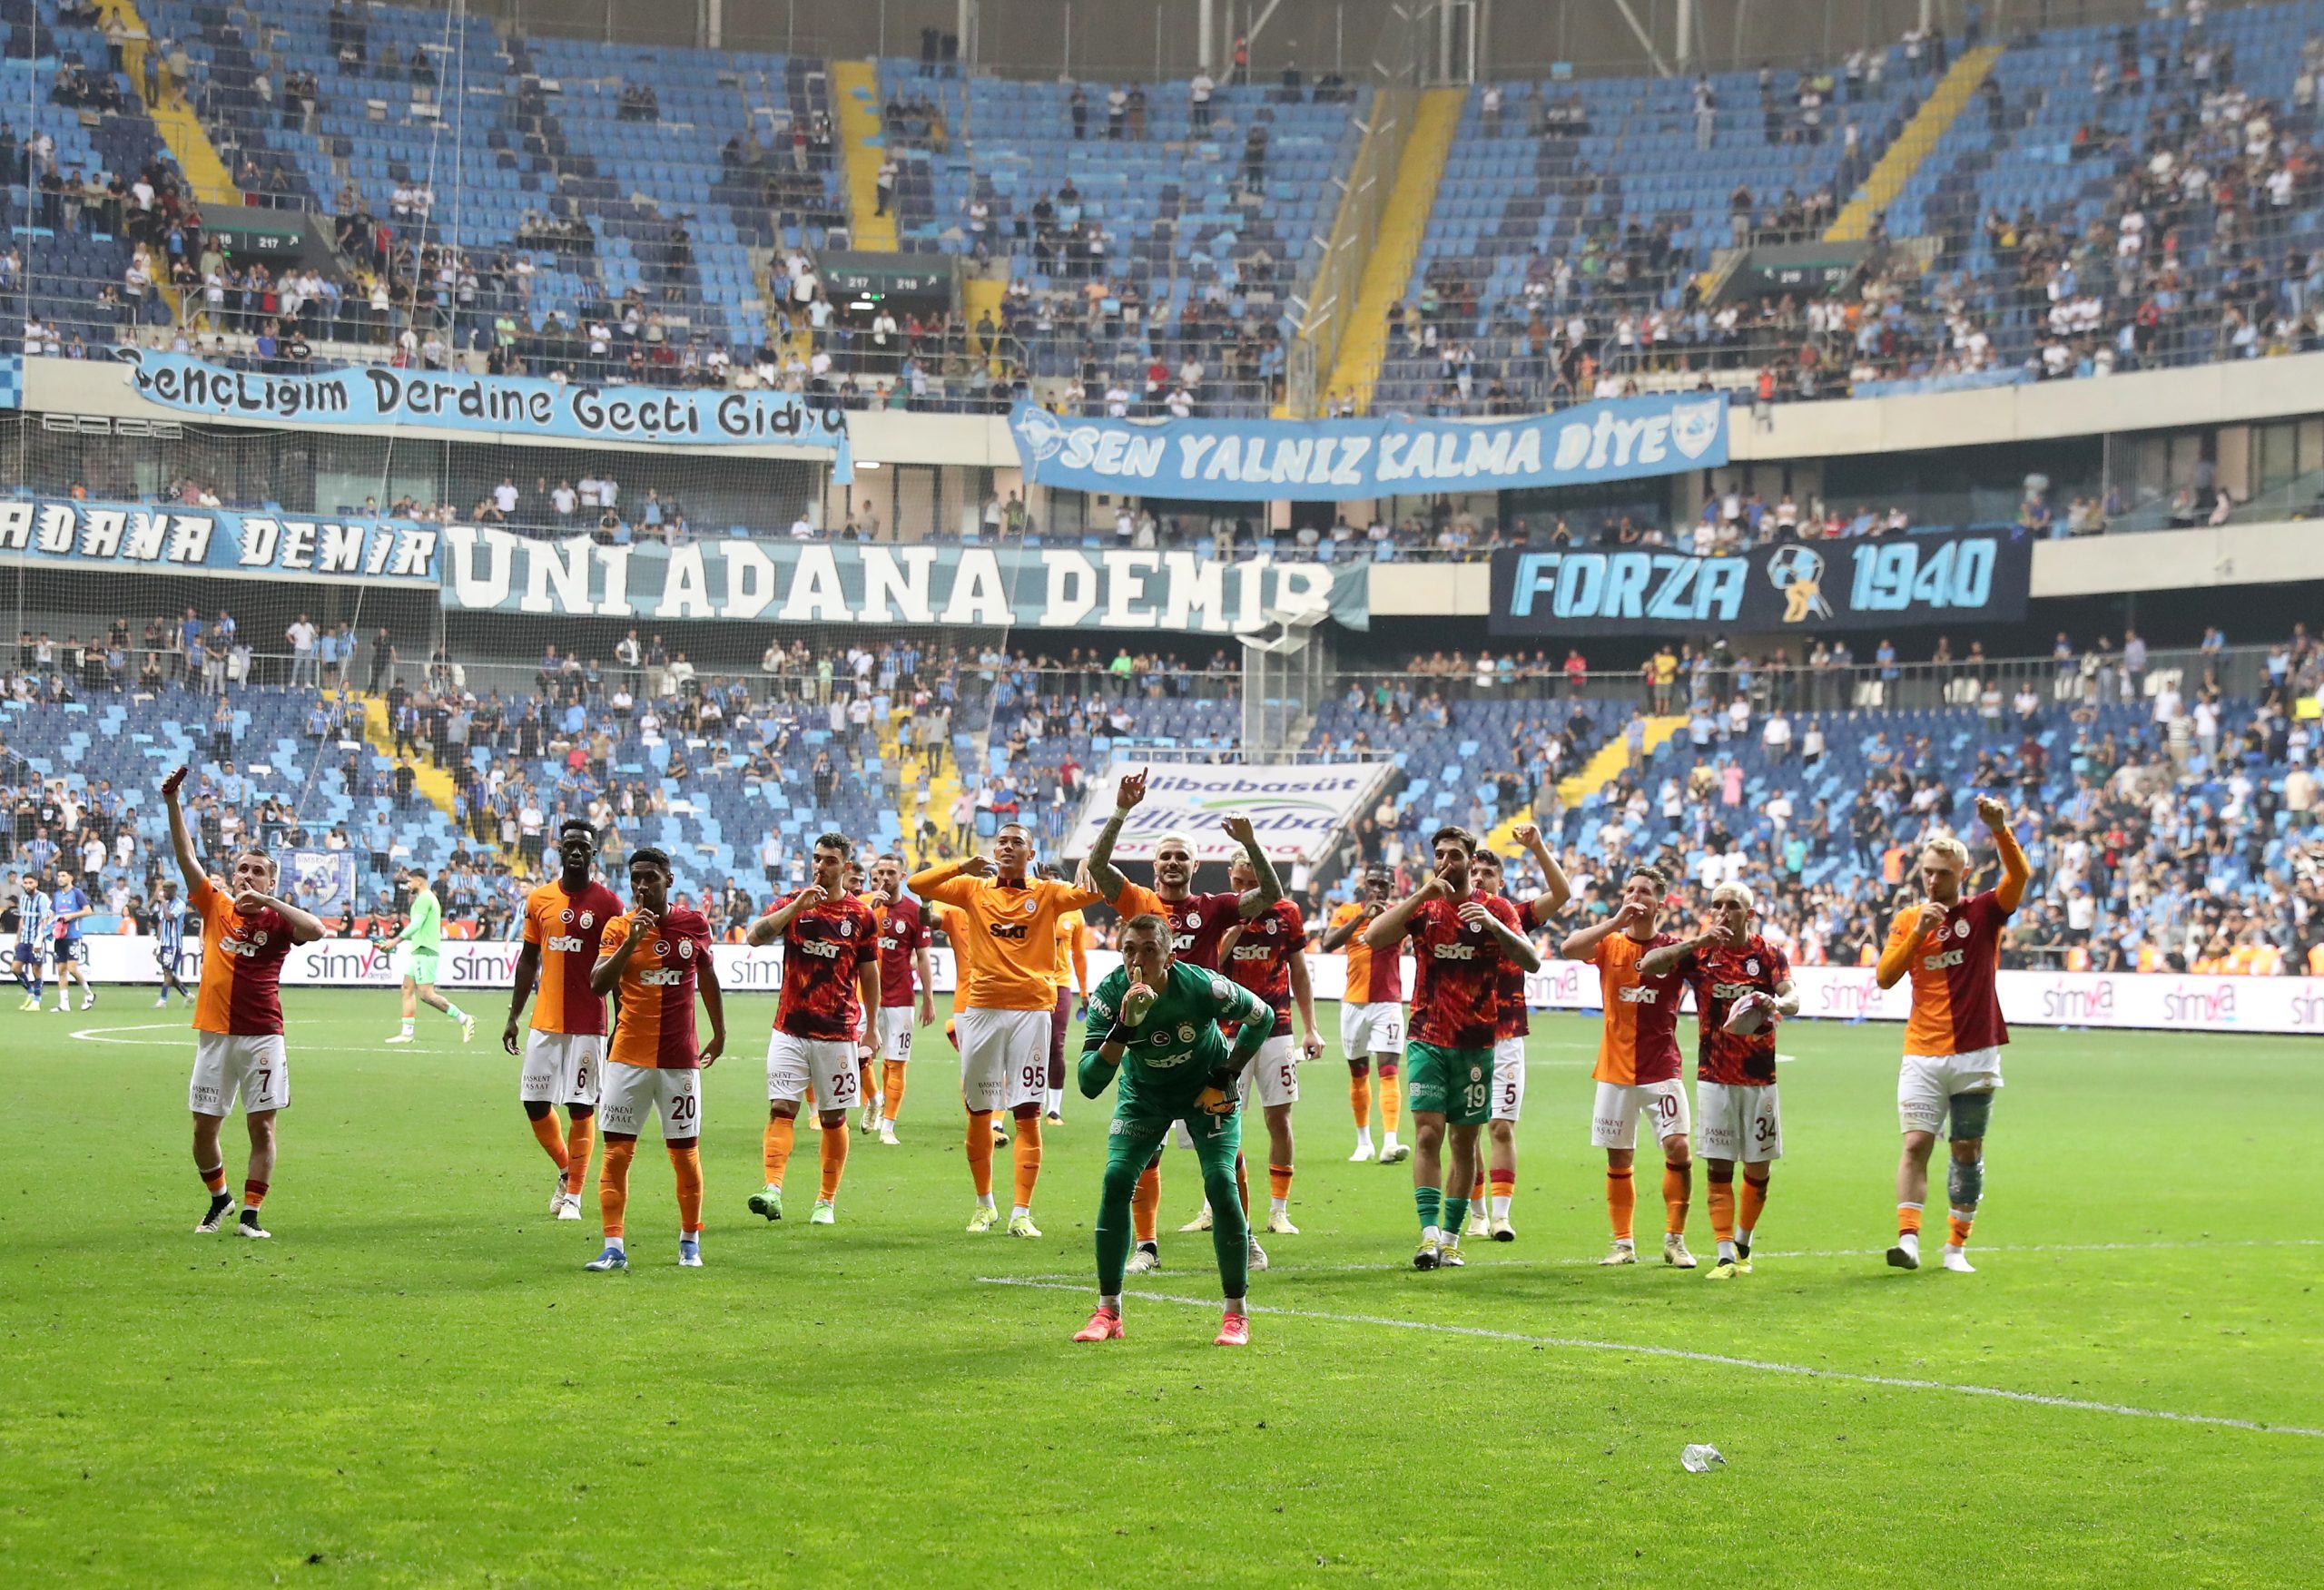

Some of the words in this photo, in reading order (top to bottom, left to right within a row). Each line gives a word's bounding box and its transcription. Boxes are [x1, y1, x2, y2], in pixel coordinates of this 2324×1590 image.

[259, 236, 279, 249] 217
[366, 368, 553, 424] Derdine
[1059, 427, 1167, 478] SEN
[1178, 433, 1372, 487] YALNIZ
[1375, 427, 1541, 482] KALMA
[655, 539, 1017, 626] ADANA
[1509, 549, 1750, 622] FORZA
[1849, 537, 1998, 613] 1940
[898, 1032, 911, 1049] 18
[1386, 1023, 1400, 1040] 17
[259, 1069, 272, 1094] 7
[577, 1067, 588, 1089] 6
[832, 1073, 857, 1097] 23
[1022, 1065, 1045, 1088] 95
[1463, 1084, 1486, 1108] 19
[1504, 1084, 1516, 1106] 5
[1658, 1094, 1678, 1119] 10
[671, 1095, 696, 1120] 20
[1755, 1116, 1777, 1142] 34
